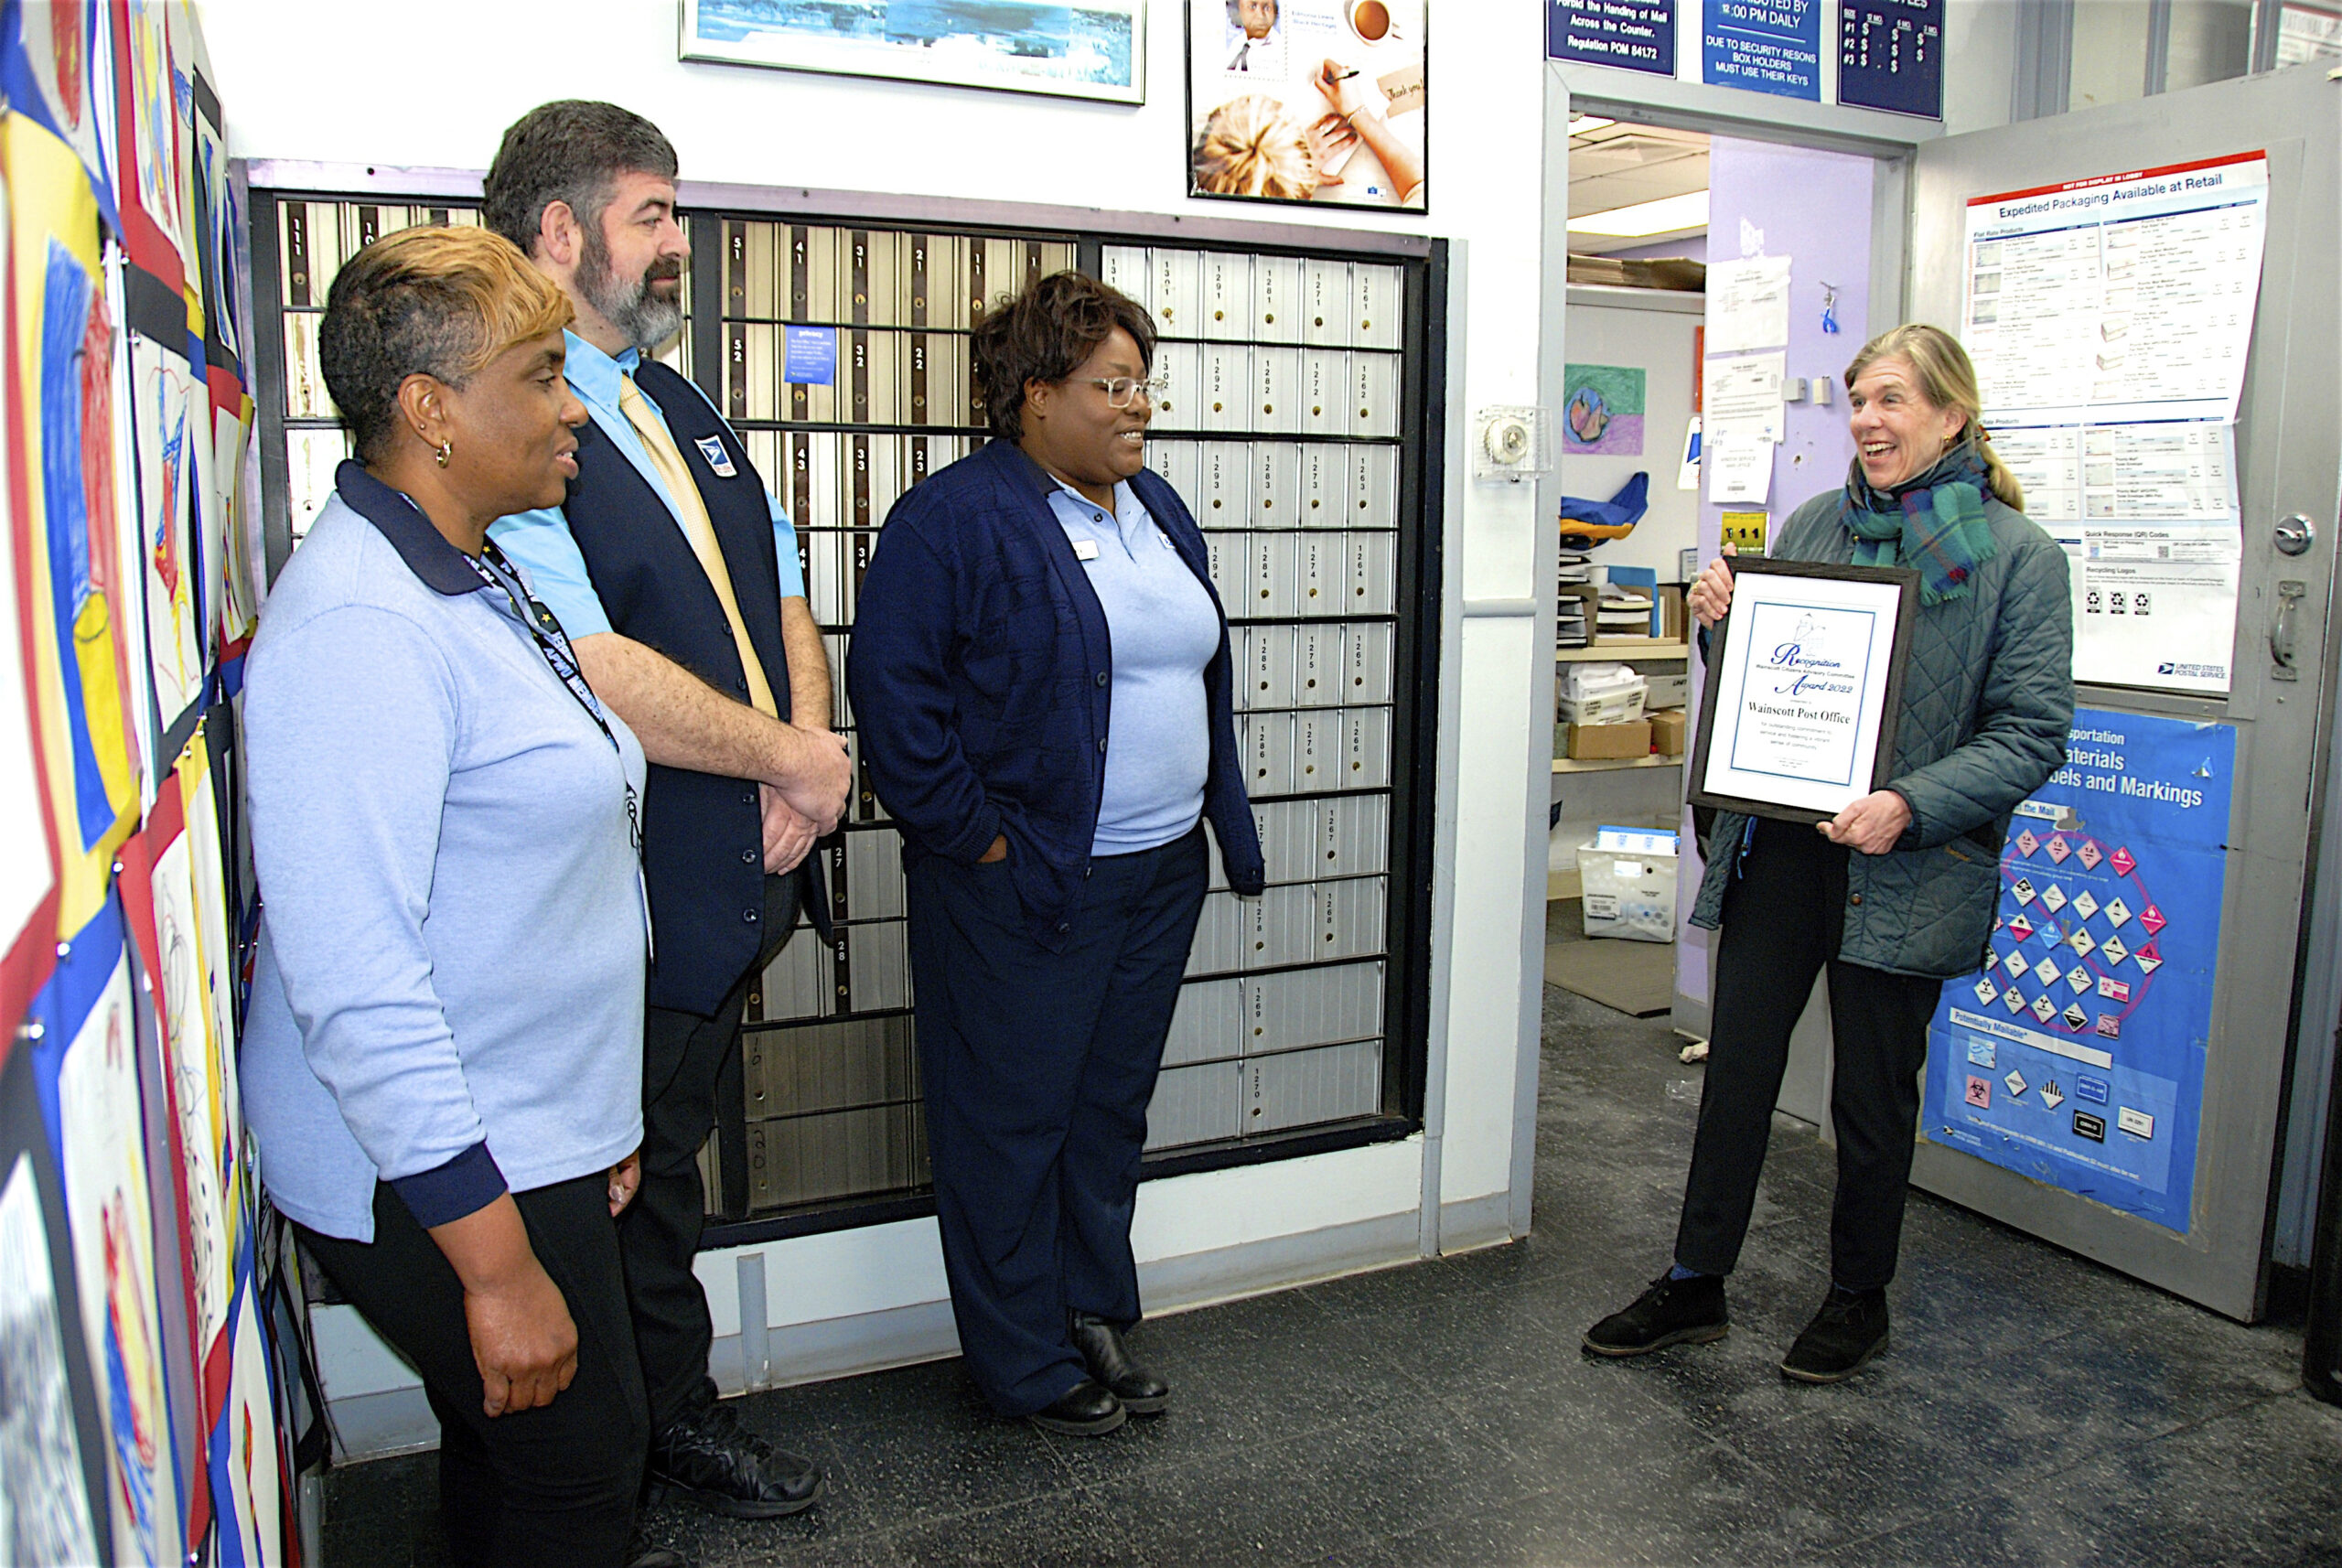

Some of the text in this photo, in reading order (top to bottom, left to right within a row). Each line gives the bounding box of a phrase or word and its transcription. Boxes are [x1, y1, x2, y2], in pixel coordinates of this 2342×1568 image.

[1586, 1, 1601, 12] the
[1638, 9, 1649, 19] of
[1650, 10, 1668, 23] Mail
[1749, 7, 1767, 22] PM
[1769, 11, 1800, 28] DAILY
[1793, 1, 1809, 14] BY
[1570, 14, 1655, 38] Across the Counter.
[1844, 22, 1924, 46] #1 $ $ $
[1567, 35, 1608, 51] Regulation
[1610, 41, 1628, 55] POM
[1706, 35, 1816, 64] DUE TO SECURITY RESONS
[1843, 38, 1924, 61] #2 $ $ $
[1733, 52, 1792, 71] BOX HOLDERS
[1843, 53, 1898, 73] #3 $ $
[1715, 61, 1809, 86] MUST USE THEIR KEYS
[1999, 173, 2223, 219] Expedited Packaging Available at Retail
[734, 237, 741, 260] 51
[795, 241, 804, 264] 41
[855, 245, 864, 268] 31
[915, 249, 924, 272] 21
[799, 330, 823, 338] privacy
[734, 338, 742, 362] 52
[855, 345, 865, 367] 32
[915, 348, 924, 370] 22
[798, 448, 806, 470] 43
[857, 448, 865, 471] 33
[916, 450, 924, 472] 23
[858, 548, 866, 569] 34
[543, 647, 574, 678] APWU
[1770, 642, 1842, 668] Recognition
[2200, 671, 2225, 679] SERVICE
[2202, 664, 2224, 672] STATES
[1774, 674, 1853, 696] Award 2022
[1748, 702, 1850, 724] Wainscott Post Office
[2068, 729, 2124, 746] sportation
[2067, 748, 2124, 770] aterials
[2049, 768, 2203, 809] bels and Markings
[2038, 806, 2055, 817] Mail
[835, 847, 843, 867] 27
[838, 941, 845, 961] 28
[1954, 1011, 1992, 1030] Potentially
